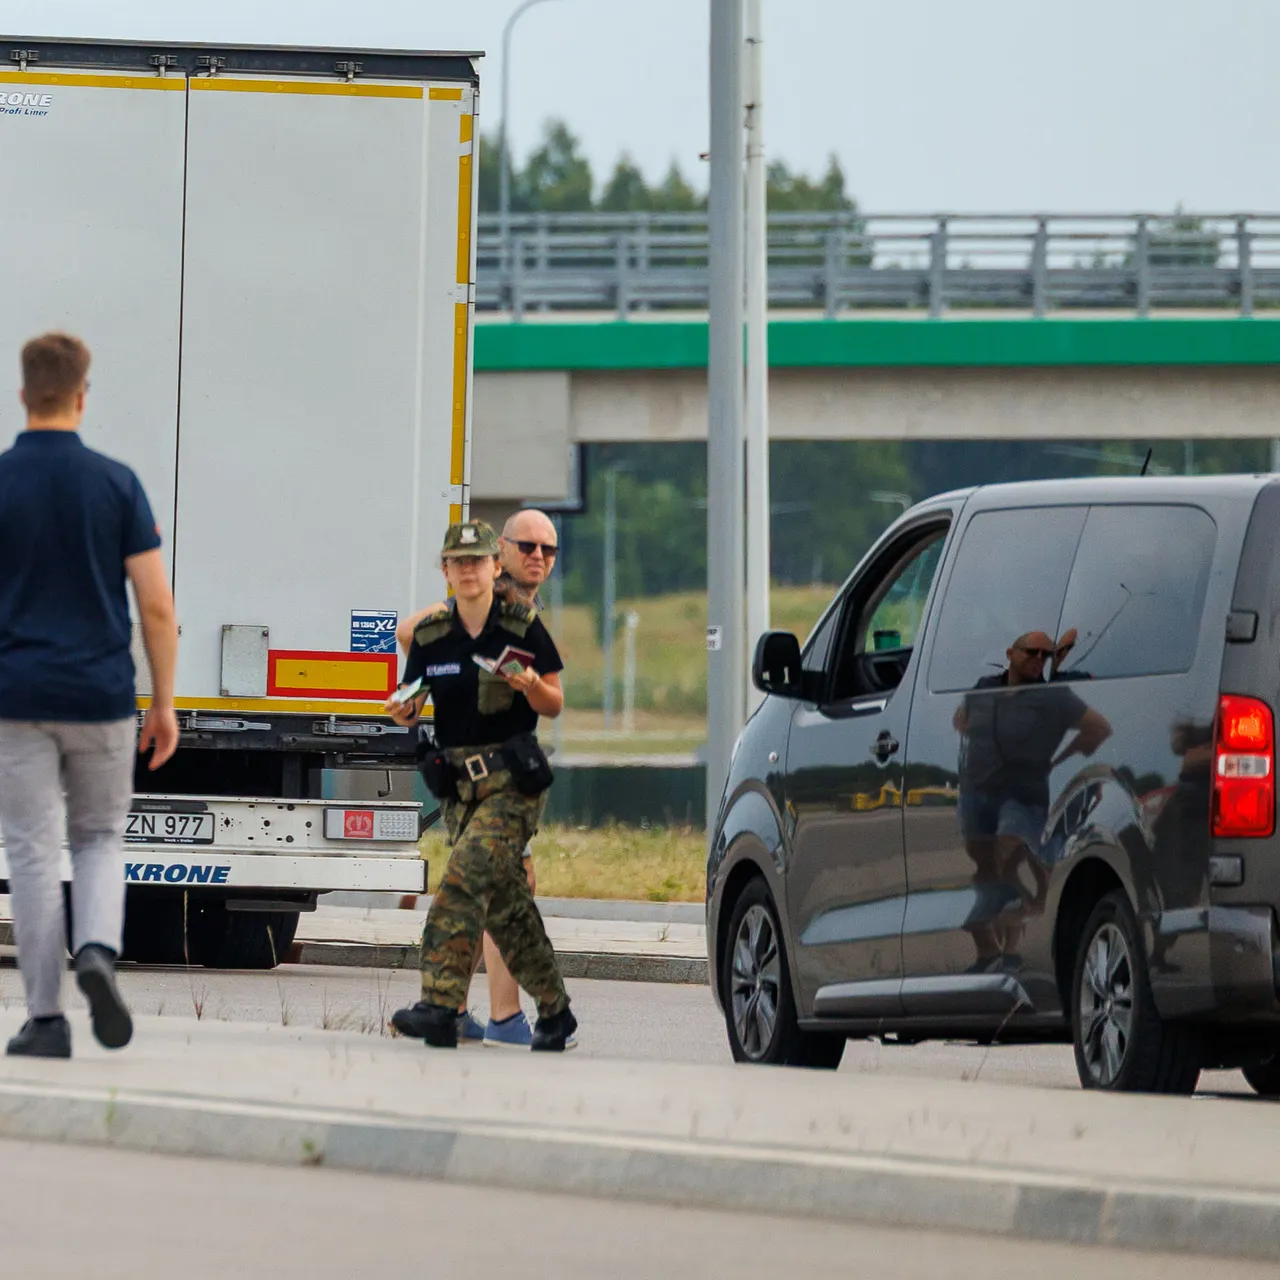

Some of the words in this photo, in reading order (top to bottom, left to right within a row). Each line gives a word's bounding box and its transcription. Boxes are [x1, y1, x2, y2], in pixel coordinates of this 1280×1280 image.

[24, 108, 48, 116] Liner
[374, 619, 396, 633] XL
[125, 814, 156, 835] ZN
[165, 816, 204, 836] 977
[124, 863, 232, 884] KRONE
